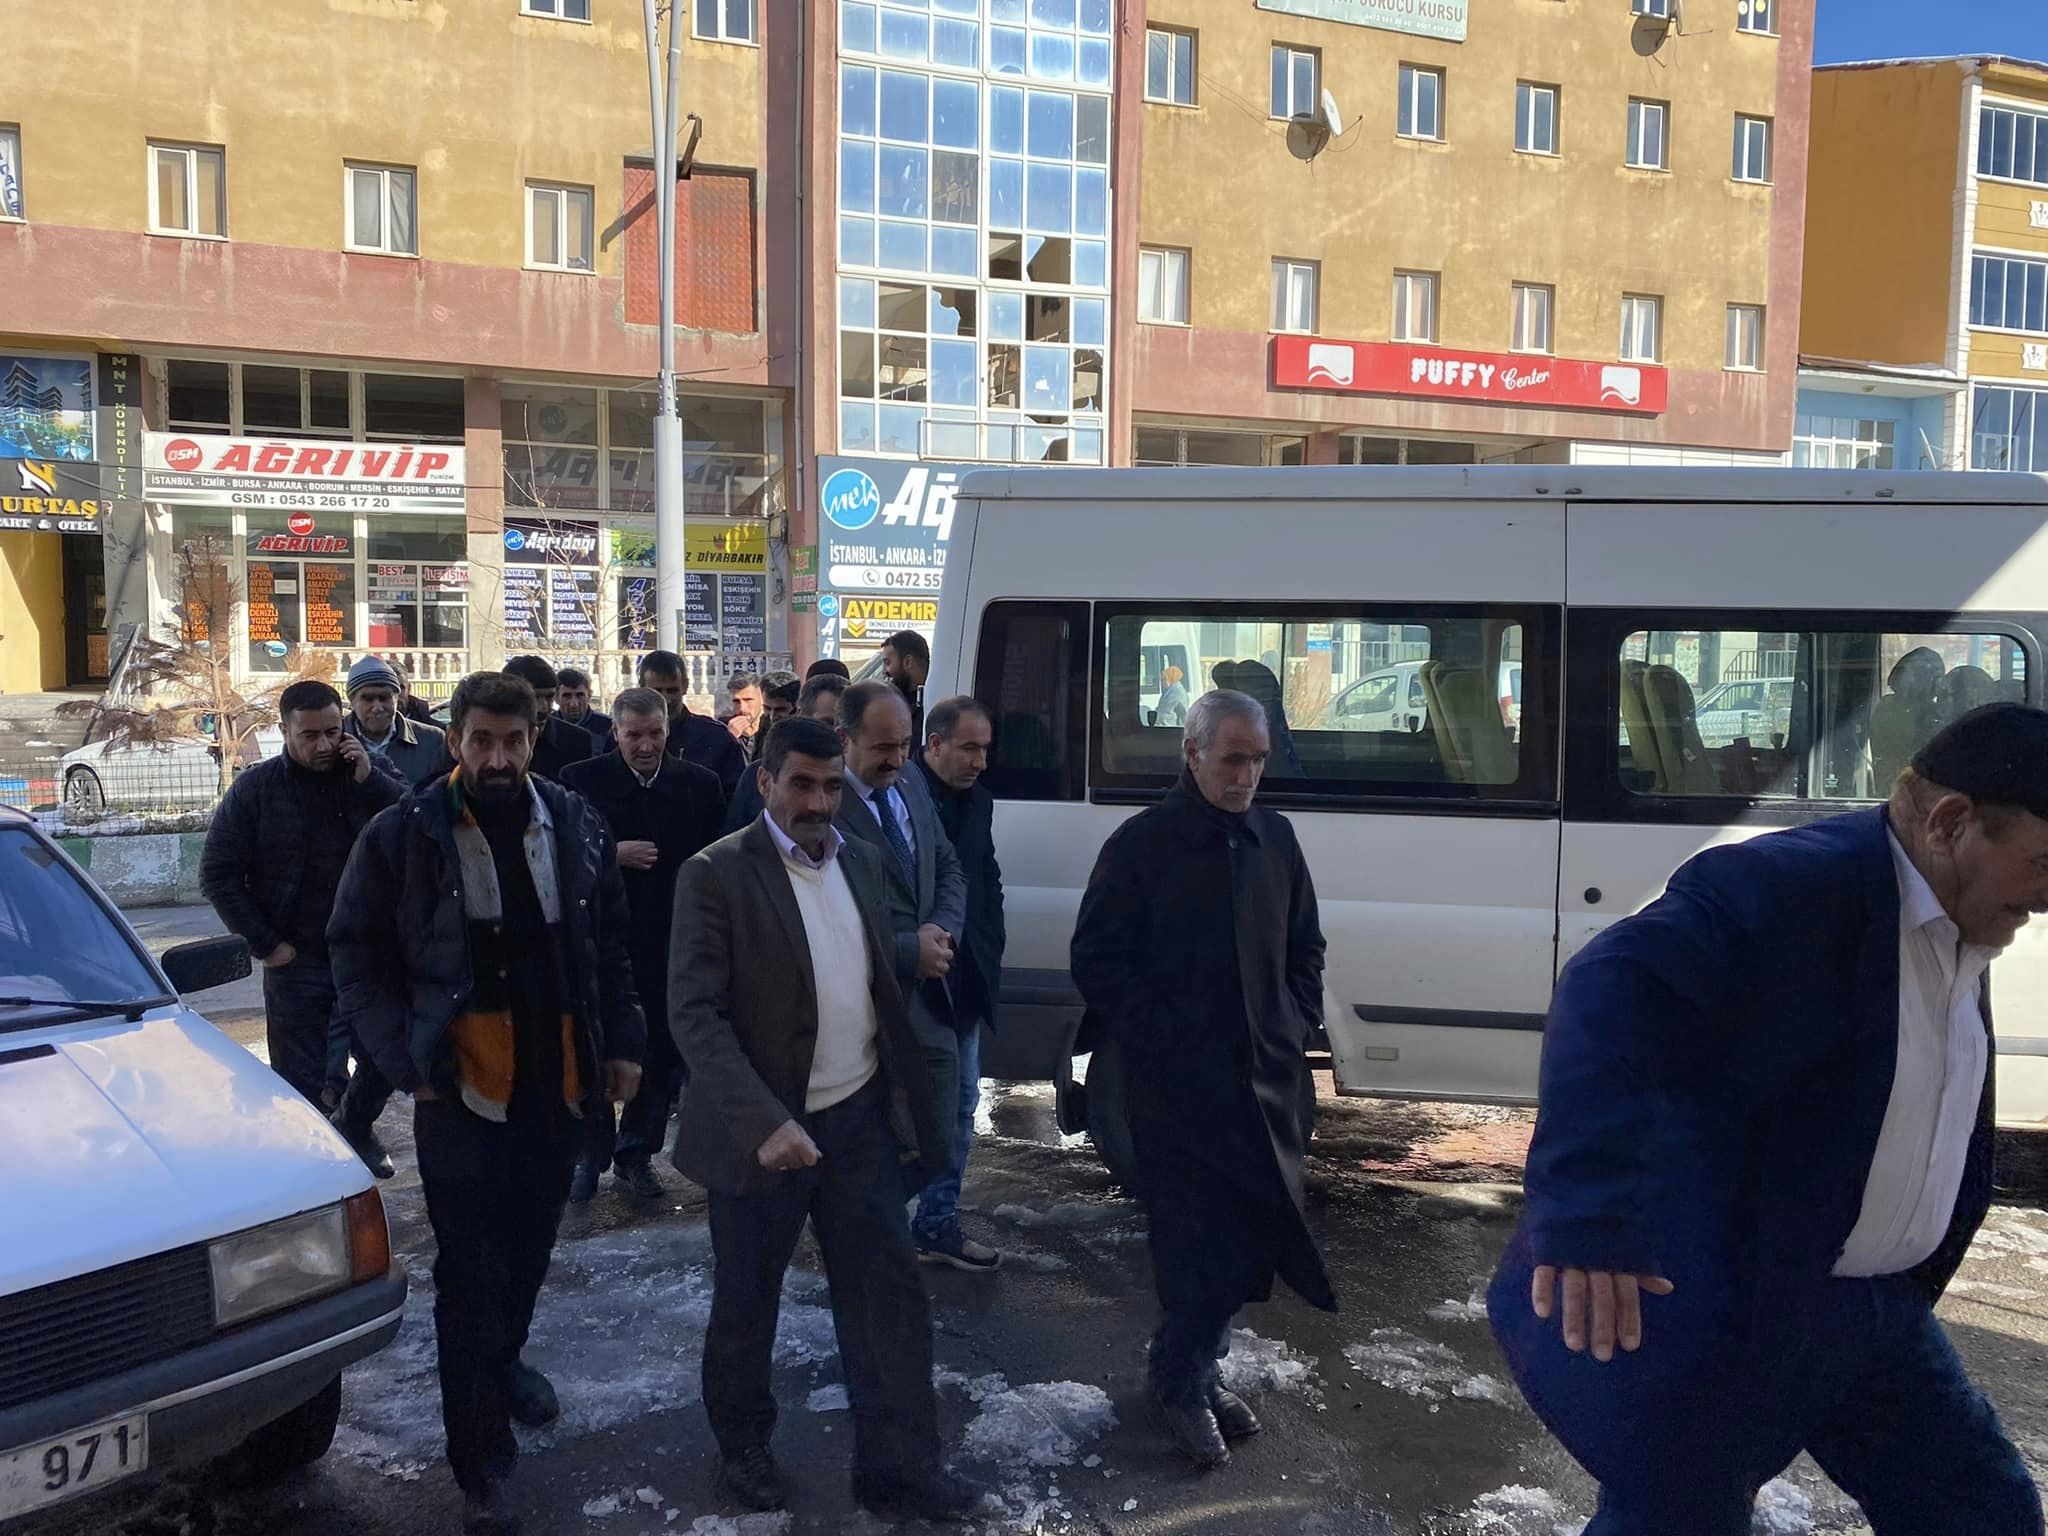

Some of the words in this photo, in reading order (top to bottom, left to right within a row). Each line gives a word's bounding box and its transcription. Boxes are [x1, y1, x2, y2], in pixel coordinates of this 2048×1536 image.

[1418, 1, 1463, 22] KURSU
[112, 356, 127, 394] MNT
[1411, 357, 1496, 389] PUFFY
[1501, 367, 1550, 390] Center
[151, 474, 194, 486] İSTANBUL
[201, 476, 226, 487] İZMİR
[232, 478, 261, 488] BURSA
[267, 480, 303, 490] ANKARA
[309, 482, 344, 491] BODRUM
[350, 482, 381, 493] MERSİN
[388, 483, 430, 495] ESKİŞEHİR
[435, 486, 461, 495] HATAY
[0, 496, 98, 519] URTAŞ
[231, 493, 266, 504] GSM
[280, 494, 315, 505] 0543
[320, 496, 346, 506] 266
[351, 497, 368, 507] 17
[372, 497, 390, 508] 20
[58, 520, 97, 531] OTEL
[697, 550, 764, 564] DİYARBAKIR
[830, 538, 878, 564] İSTANBUL
[885, 547, 926, 566] ANKARA
[378, 565, 405, 576] BEST
[885, 571, 920, 587] 0472
[924, 573, 942, 588] 55
[723, 585, 761, 594] ESKİŞEHİR
[723, 604, 747, 613] SÖKE
[844, 600, 937, 620] AYDEMİR
[251, 617, 278, 625] YOZGAT
[250, 632, 281, 640] ANKARA
[308, 633, 342, 641] ERZURUM
[43, 1424, 129, 1491] 971
